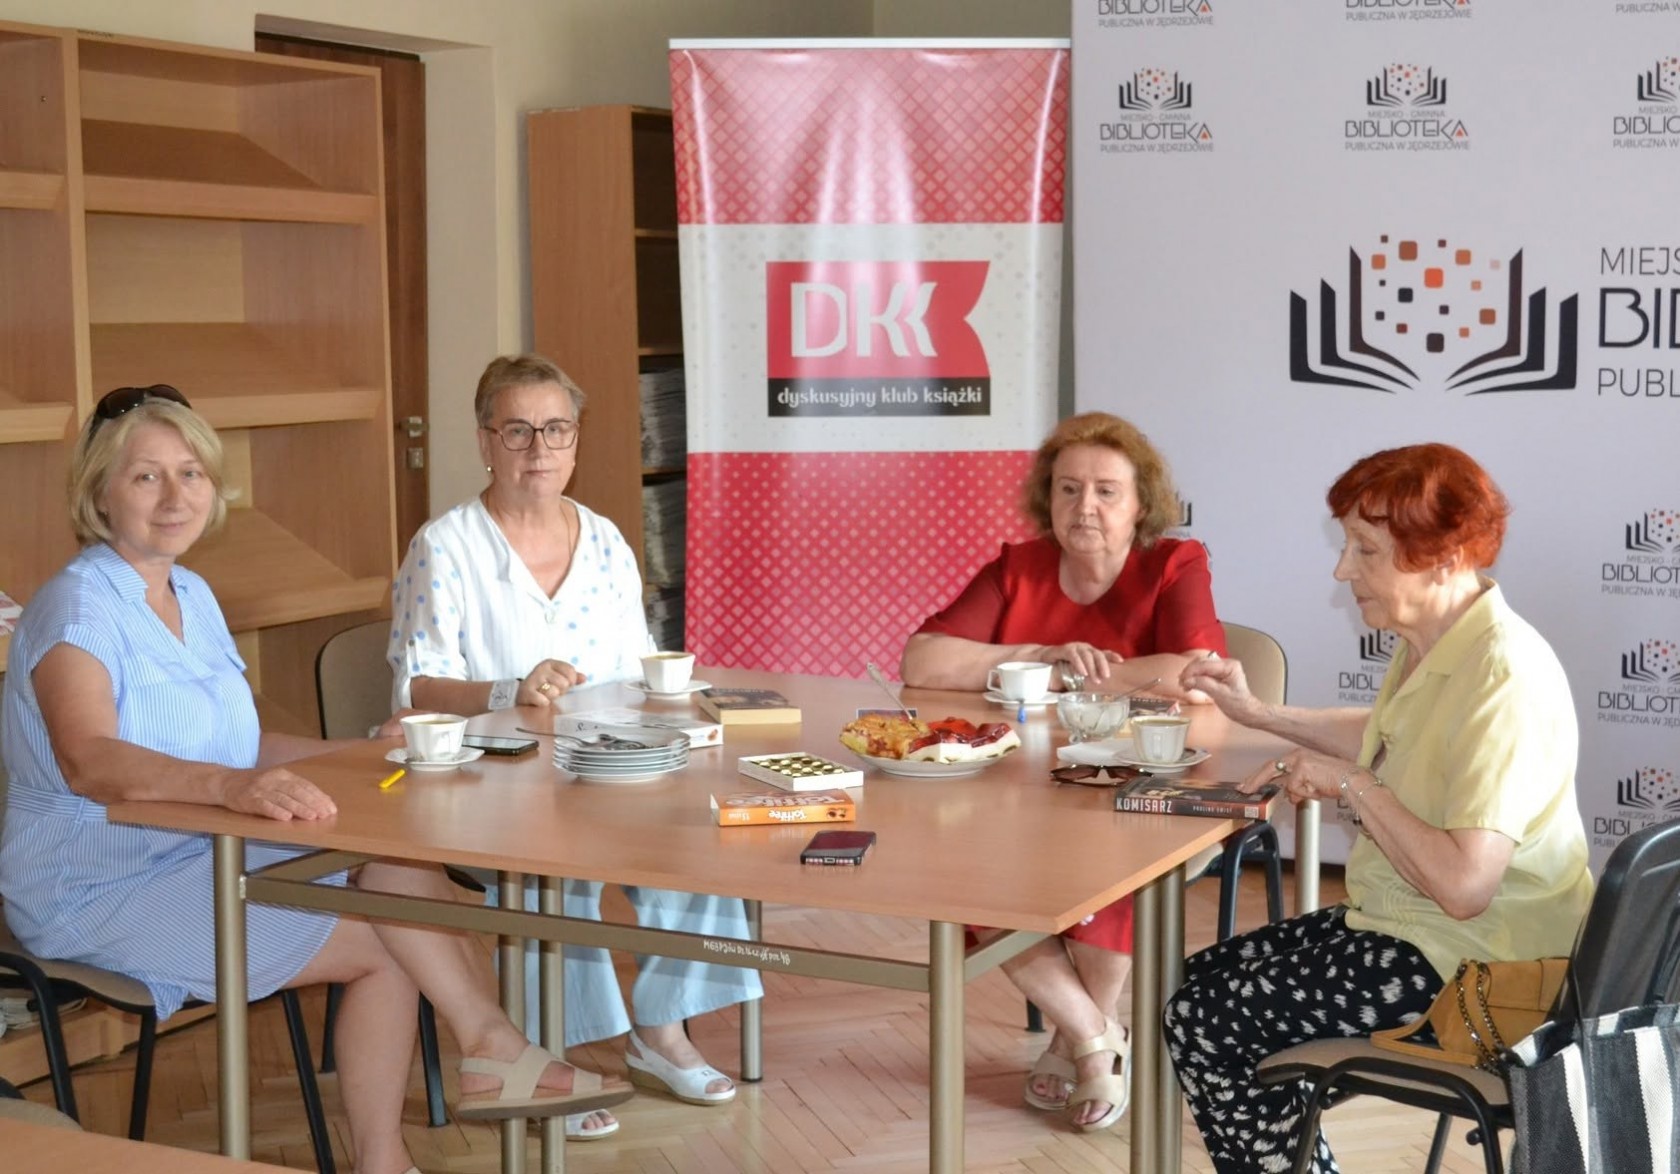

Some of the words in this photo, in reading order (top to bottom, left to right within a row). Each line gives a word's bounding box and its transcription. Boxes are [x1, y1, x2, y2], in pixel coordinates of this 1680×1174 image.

[1098, 0, 1212, 16] BIBLIOTEKA
[1346, 10, 1396, 21] PUBLICZNA
[1398, 10, 1407, 19] W
[1615, 3, 1669, 13] PUBLICZNA
[1098, 17, 1144, 27] PUBLICZNA
[1146, 17, 1155, 26] W
[1099, 122, 1213, 144] BIBLIOTEKA
[1344, 119, 1469, 141] BIBLIOTEKA
[1100, 143, 1146, 153] PUBLICZNA
[1146, 143, 1156, 152] W
[1344, 141, 1395, 152] PUBLICZNA
[1396, 141, 1406, 150] W
[1613, 138, 1667, 149] PUBLICZNA
[1598, 287, 1680, 349] BI
[777, 387, 877, 409] dyskusyjny
[881, 385, 919, 404] klub
[923, 385, 983, 407] książki
[1602, 562, 1680, 585] BIBLIOT
[1601, 584, 1654, 597] PUBLICZNA
[1116, 797, 1173, 814] KOMISARZ
[768, 808, 808, 824] Toffifee
